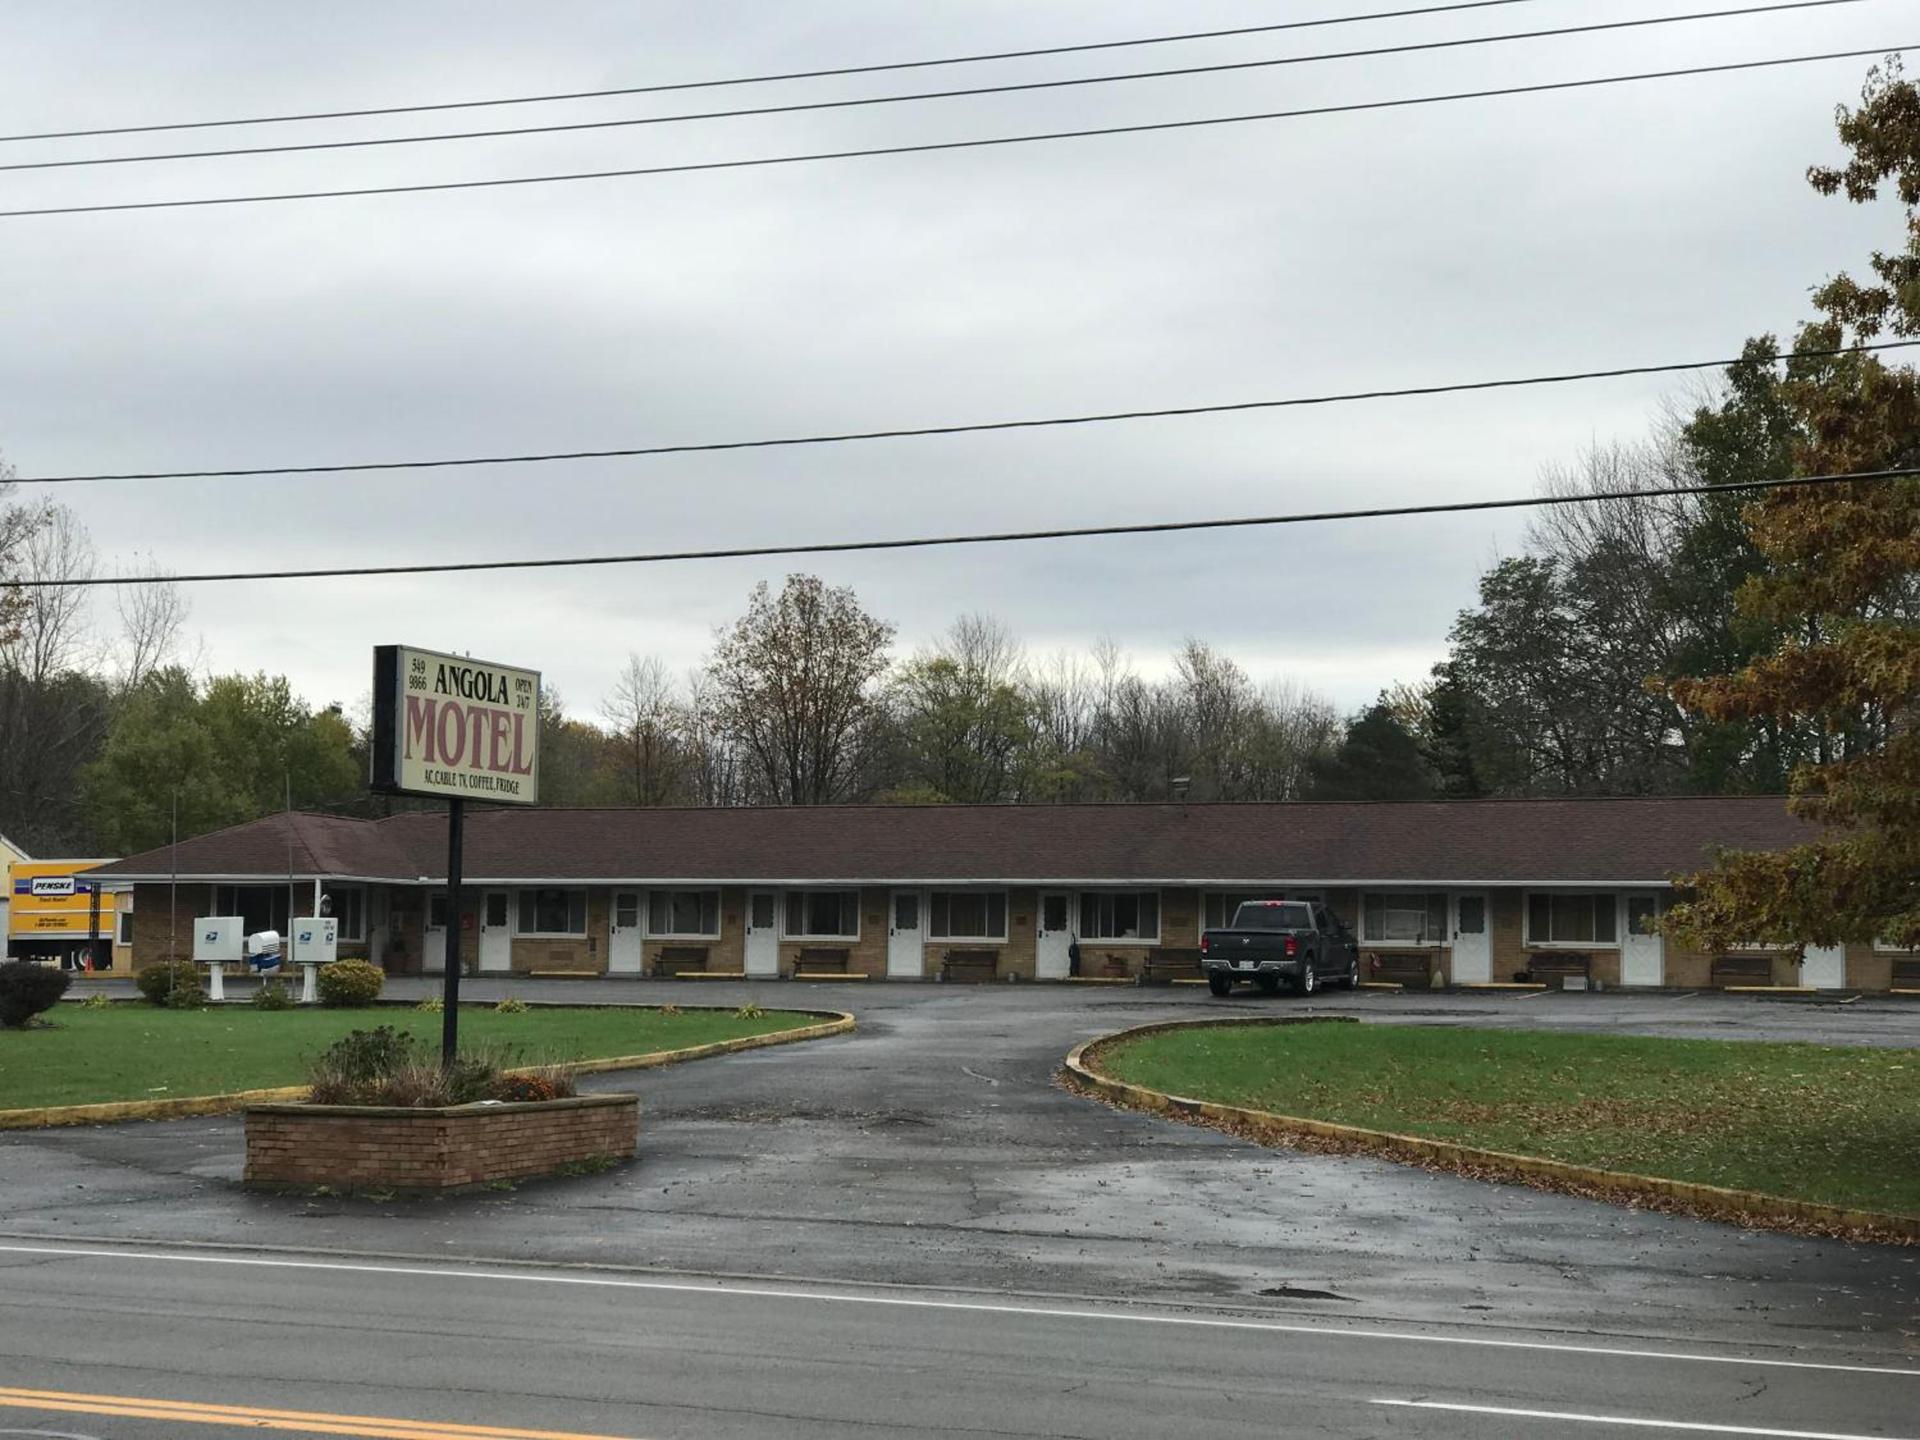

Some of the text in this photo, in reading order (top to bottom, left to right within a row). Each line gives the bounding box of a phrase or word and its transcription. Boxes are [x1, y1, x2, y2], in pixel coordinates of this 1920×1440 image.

[412, 658, 426, 674] 549
[435, 664, 509, 705] ANGOLA
[515, 678, 532, 694] OPEN
[404, 695, 534, 776] MOTEL
[34, 882, 72, 890] PENSKE
